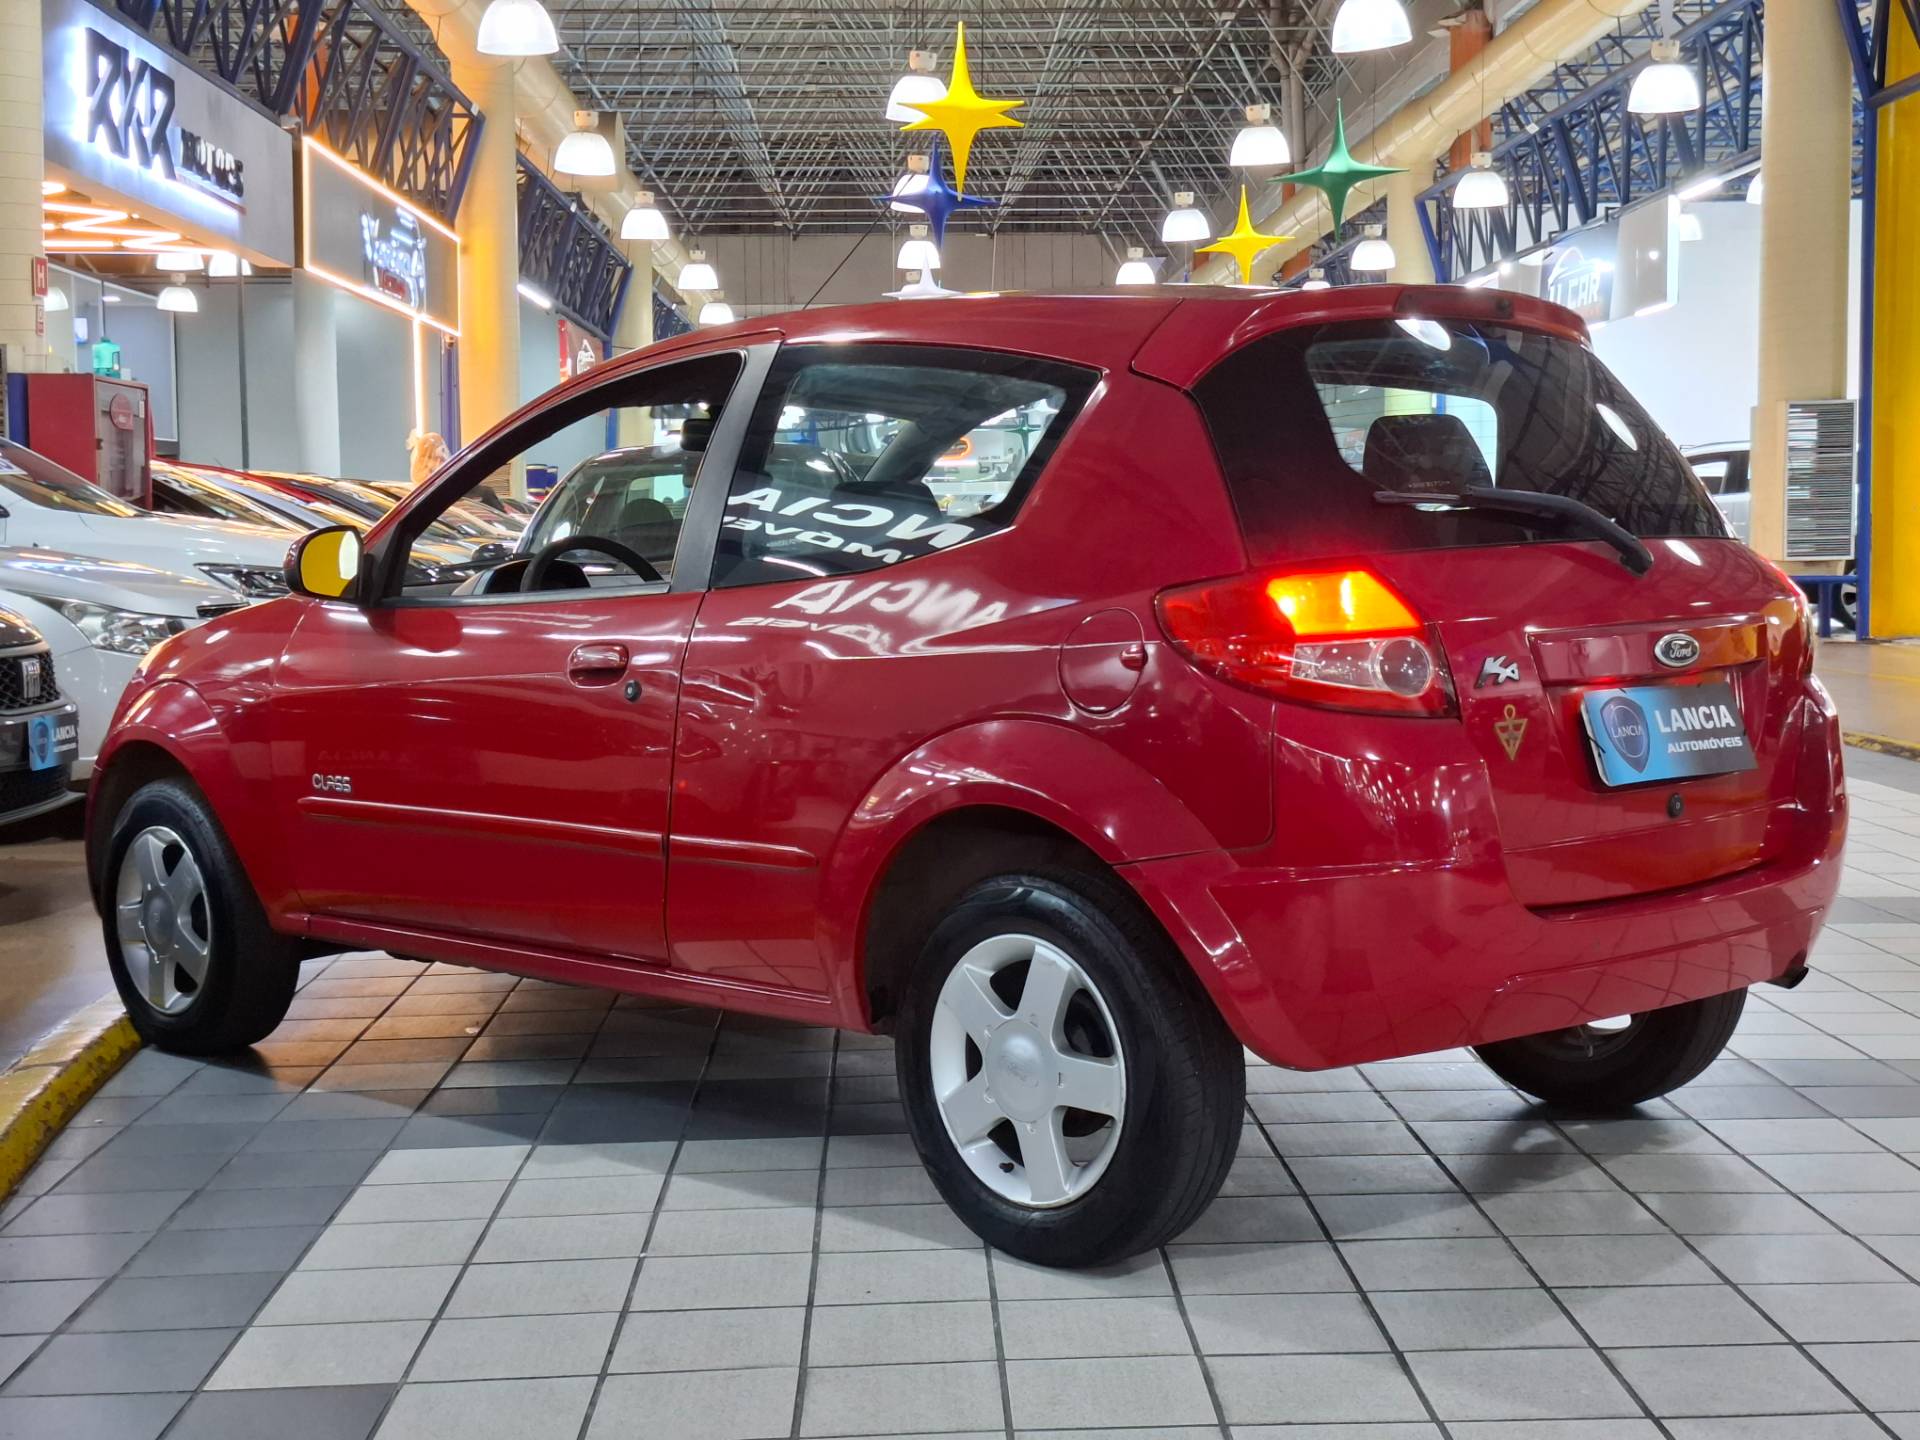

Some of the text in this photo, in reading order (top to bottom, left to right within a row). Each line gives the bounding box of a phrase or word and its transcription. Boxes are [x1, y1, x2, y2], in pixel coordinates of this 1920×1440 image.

[179, 126, 244, 198] MOTORS
[1669, 640, 1692, 658] Ford
[1655, 704, 1736, 733] LANCIA
[1612, 723, 1643, 738] LANCIA
[1667, 736, 1743, 754] AUTOMÓVEIS
[312, 773, 352, 793] CLASS
